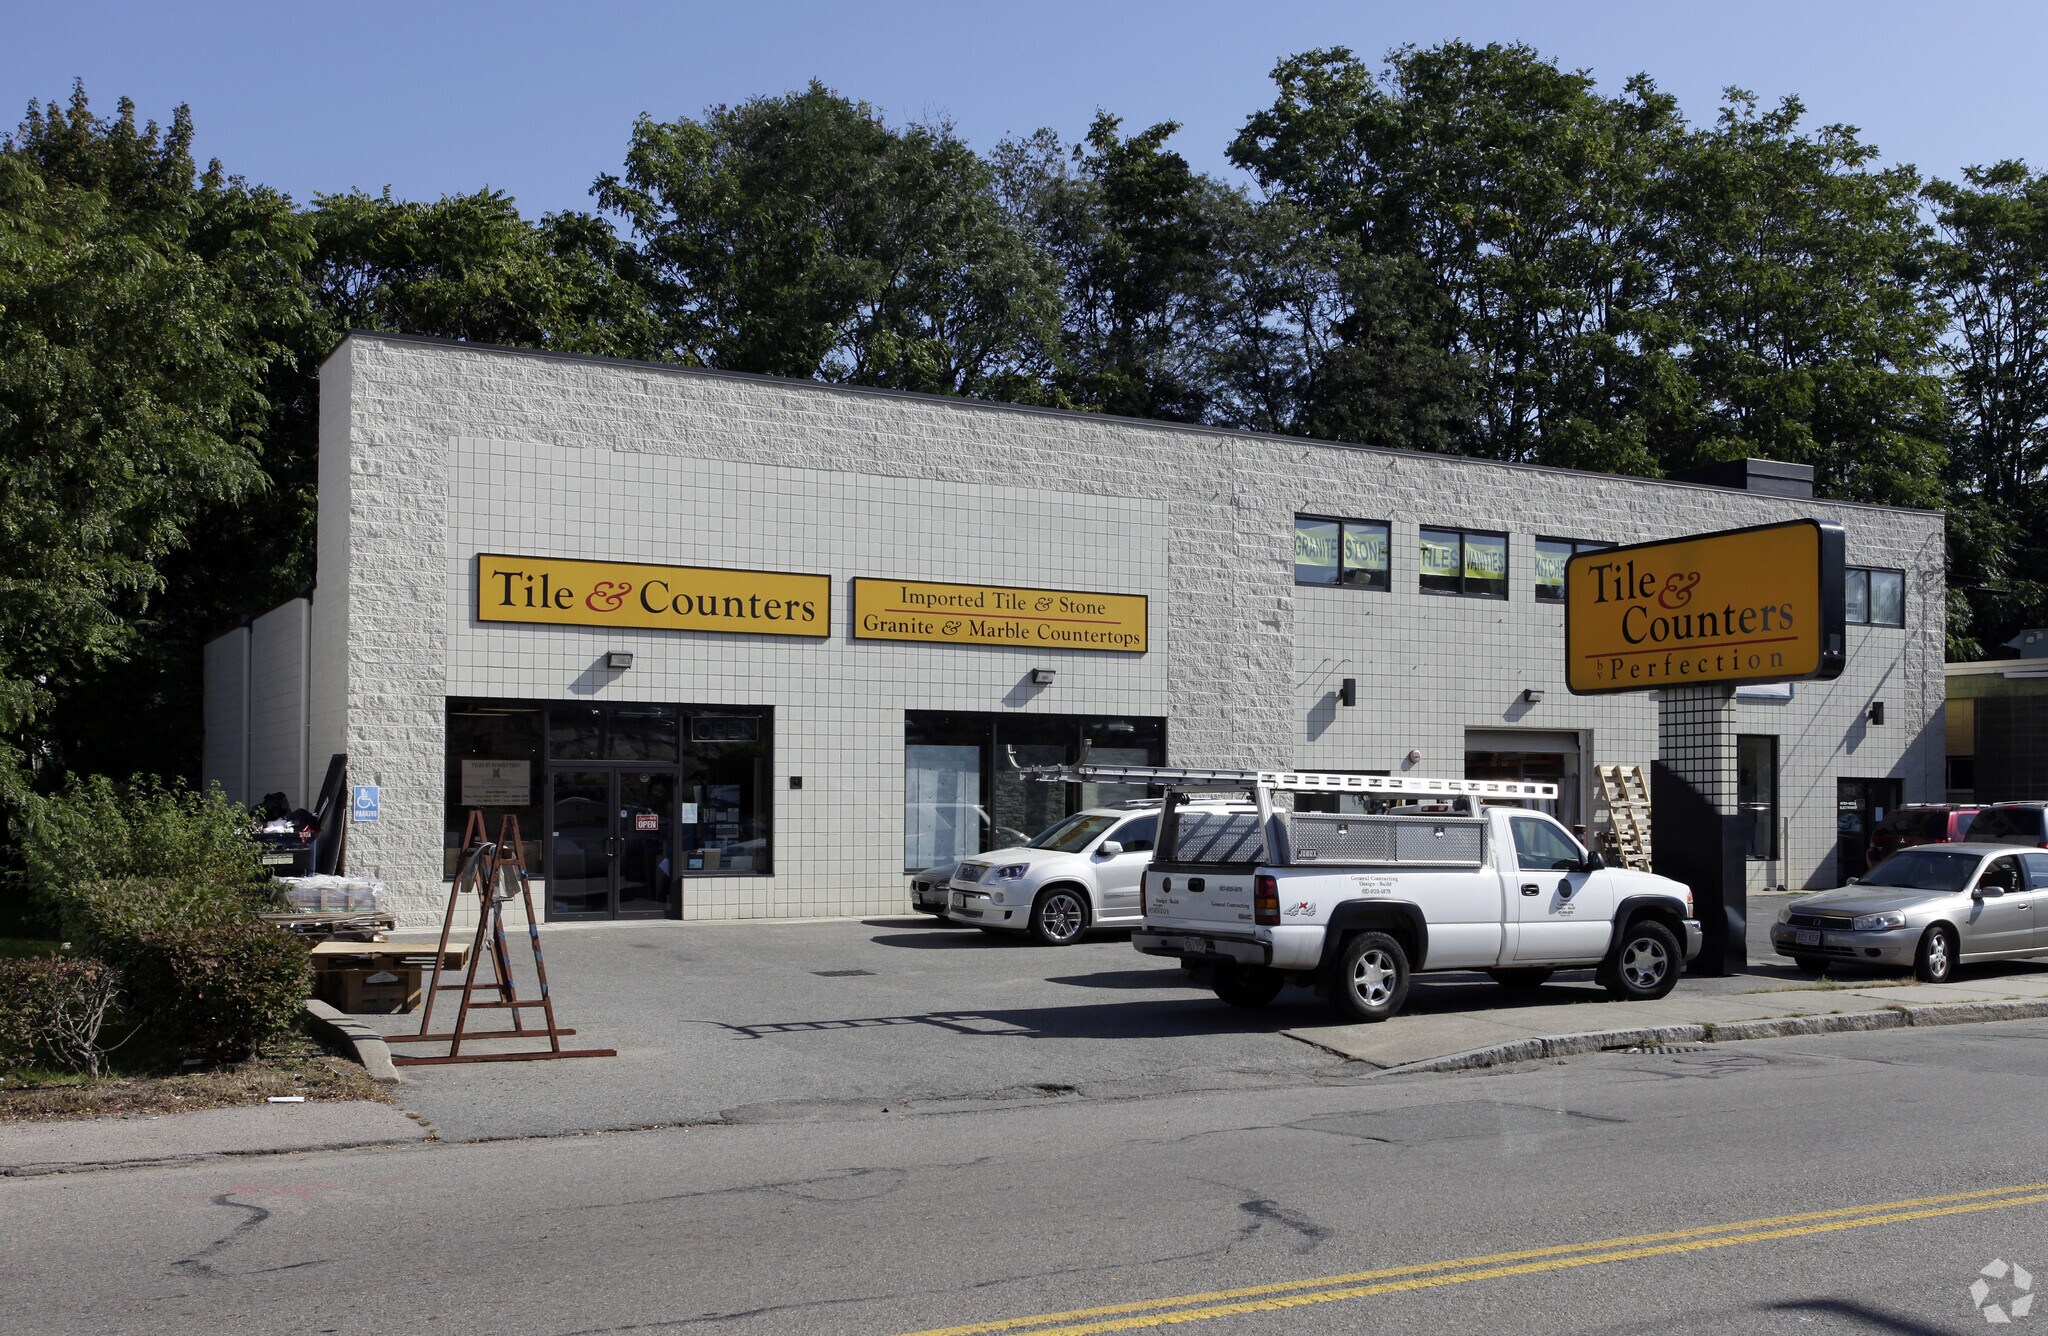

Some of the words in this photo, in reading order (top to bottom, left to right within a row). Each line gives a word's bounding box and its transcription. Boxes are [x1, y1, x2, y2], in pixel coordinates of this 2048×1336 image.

[1295, 536, 1337, 559] GRANITE
[1345, 539, 1385, 562] STONE
[1421, 546, 1459, 568] TILES
[1466, 550, 1504, 571] VANITIES
[491, 570, 574, 610] Tile
[585, 581, 632, 612] &
[640, 580, 815, 622] Counters
[1588, 560, 1656, 604] Tile
[1658, 571, 1700, 609] &
[901, 586, 984, 609] Imported
[992, 592, 1026, 611] Tile
[1034, 597, 1054, 612] &
[1059, 597, 1106, 615] Stone
[863, 614, 934, 635] Granite
[941, 621, 962, 636] &
[969, 620, 1030, 640] Marble
[1037, 624, 1140, 647] Countertops
[1622, 603, 1794, 644] Counters
[1610, 649, 1784, 680] Perfection
[638, 821, 656, 829] OPEN
